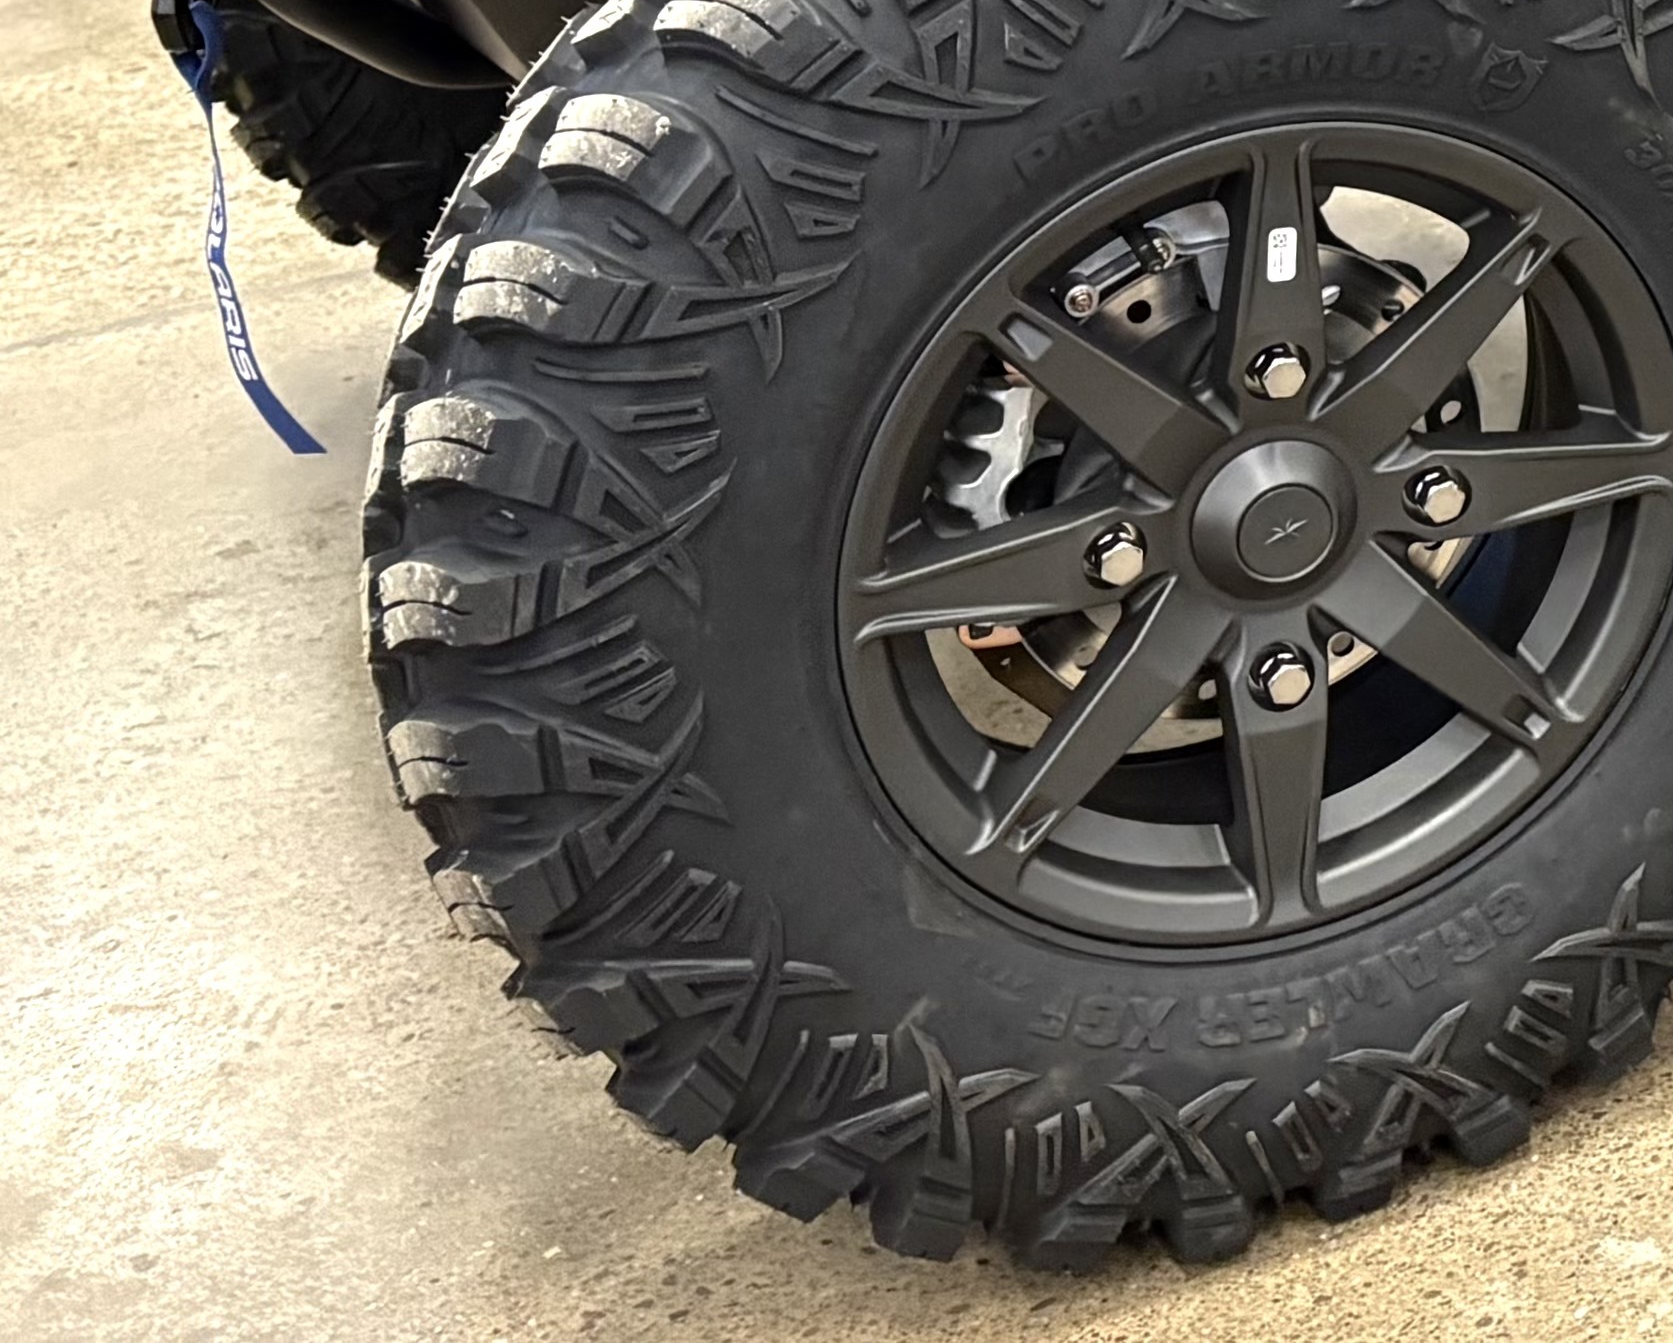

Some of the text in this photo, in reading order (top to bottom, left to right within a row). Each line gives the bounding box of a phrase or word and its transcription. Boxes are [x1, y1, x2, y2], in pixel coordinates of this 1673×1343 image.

[1013, 42, 1447, 187] PRO ARMOR
[1197, 881, 1536, 1049] CRAWLER
